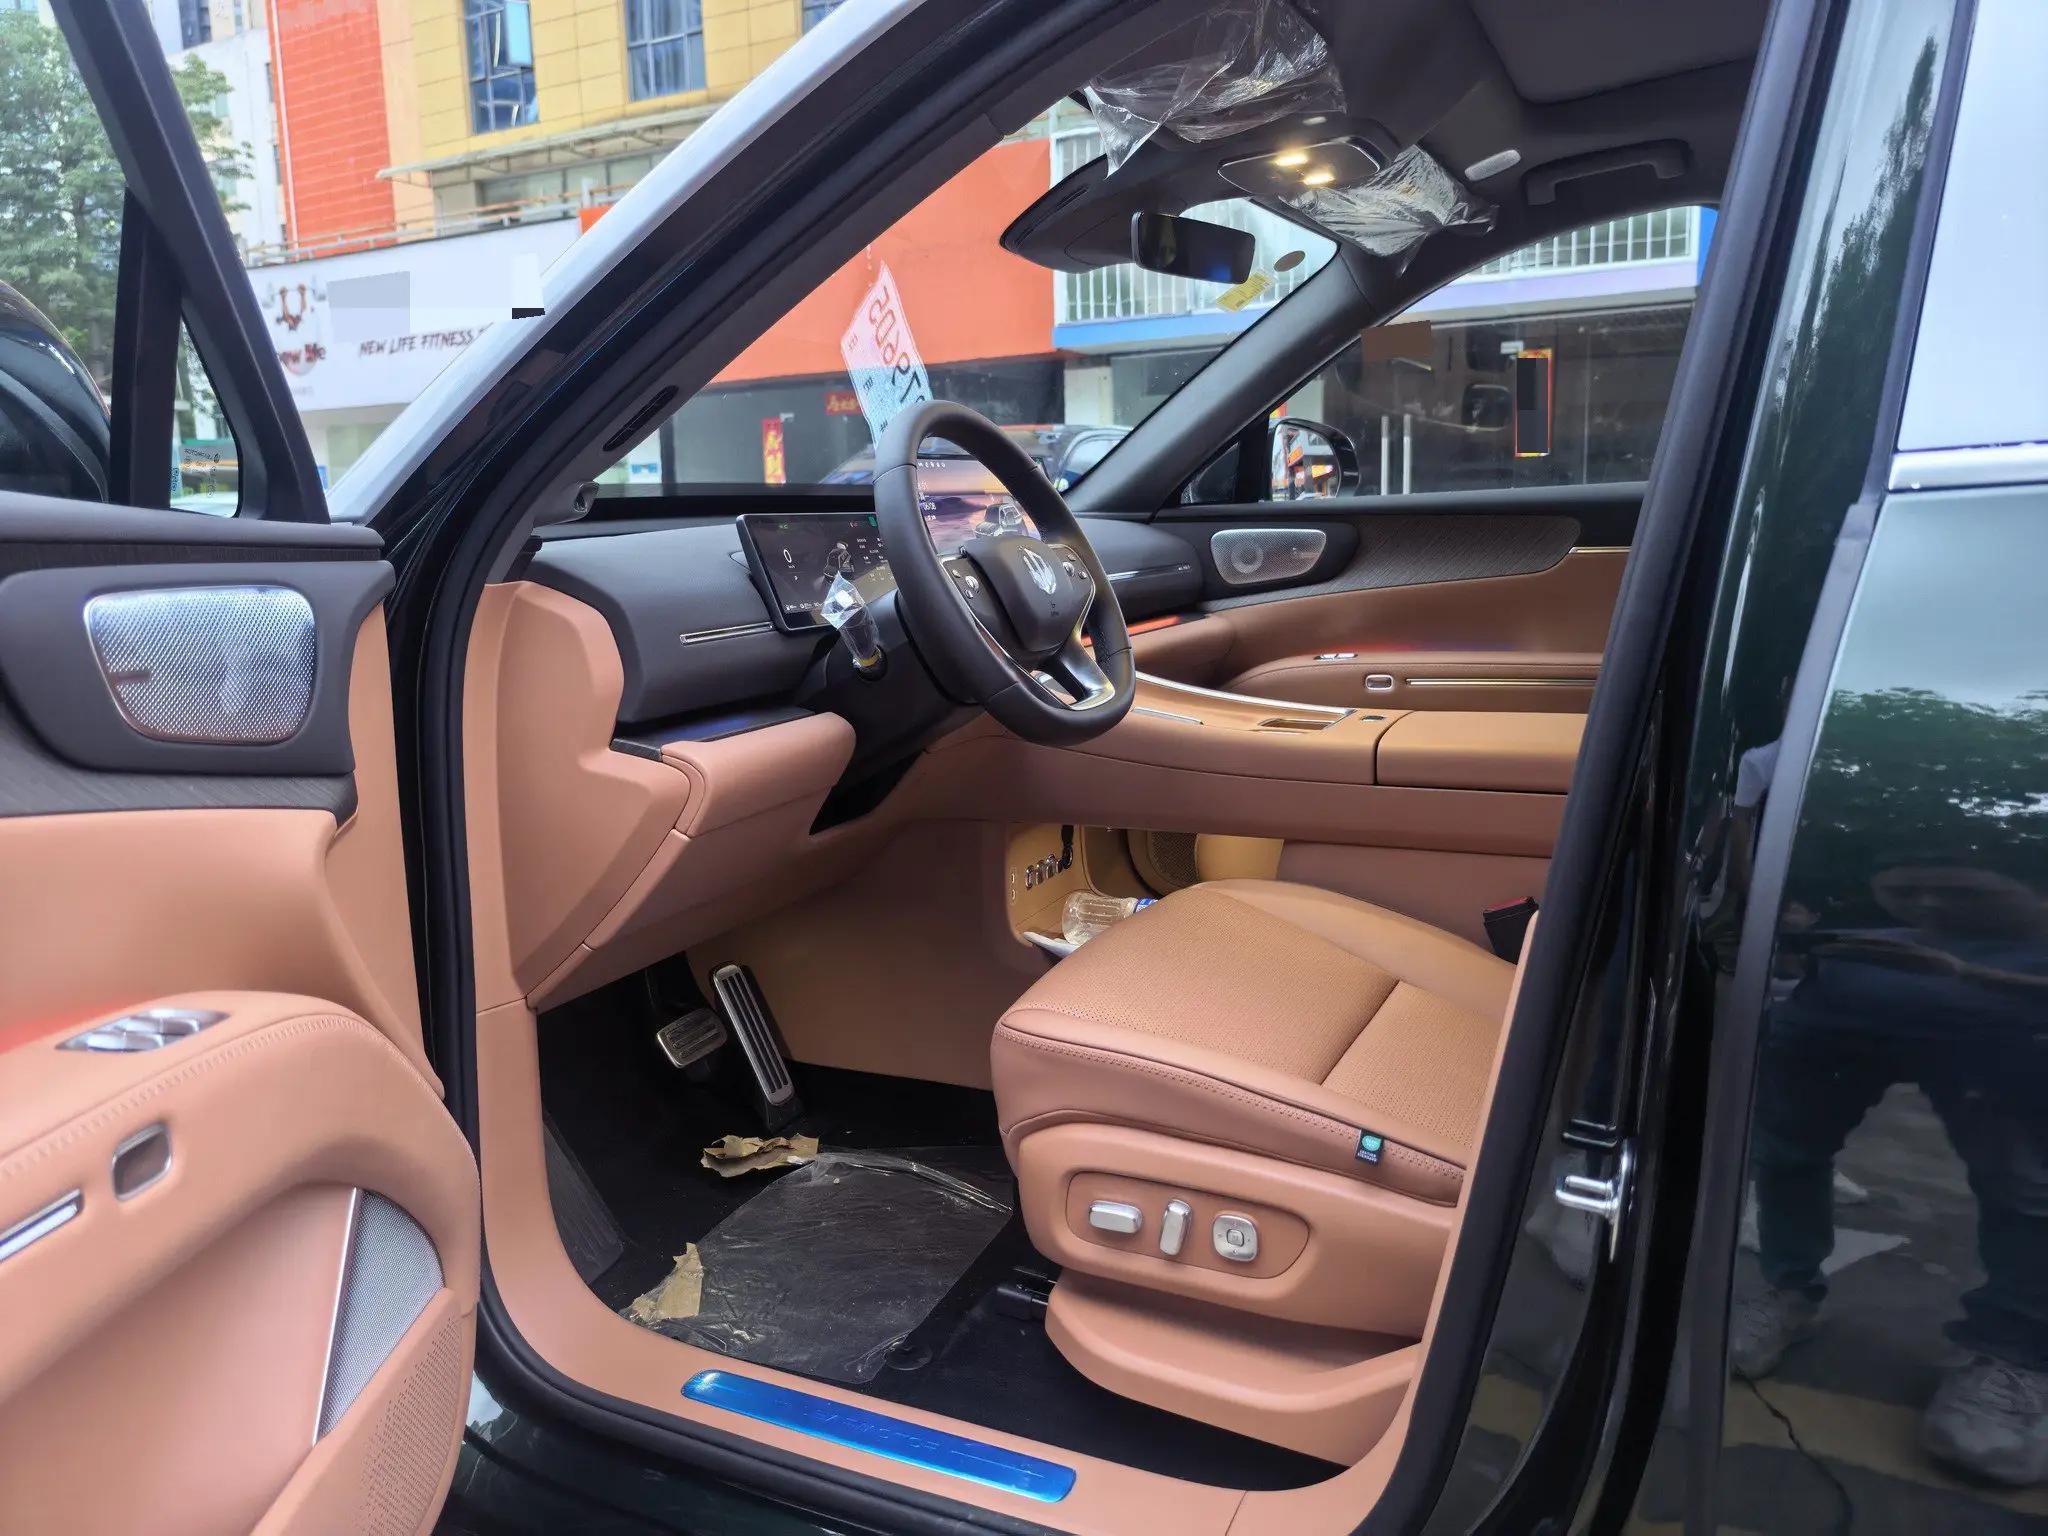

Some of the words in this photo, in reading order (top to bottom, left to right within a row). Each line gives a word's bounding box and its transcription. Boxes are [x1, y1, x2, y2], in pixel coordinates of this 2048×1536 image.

[359, 339, 387, 356] NEW
[388, 335, 418, 355] LIFE
[420, 328, 474, 351] FITNESS
